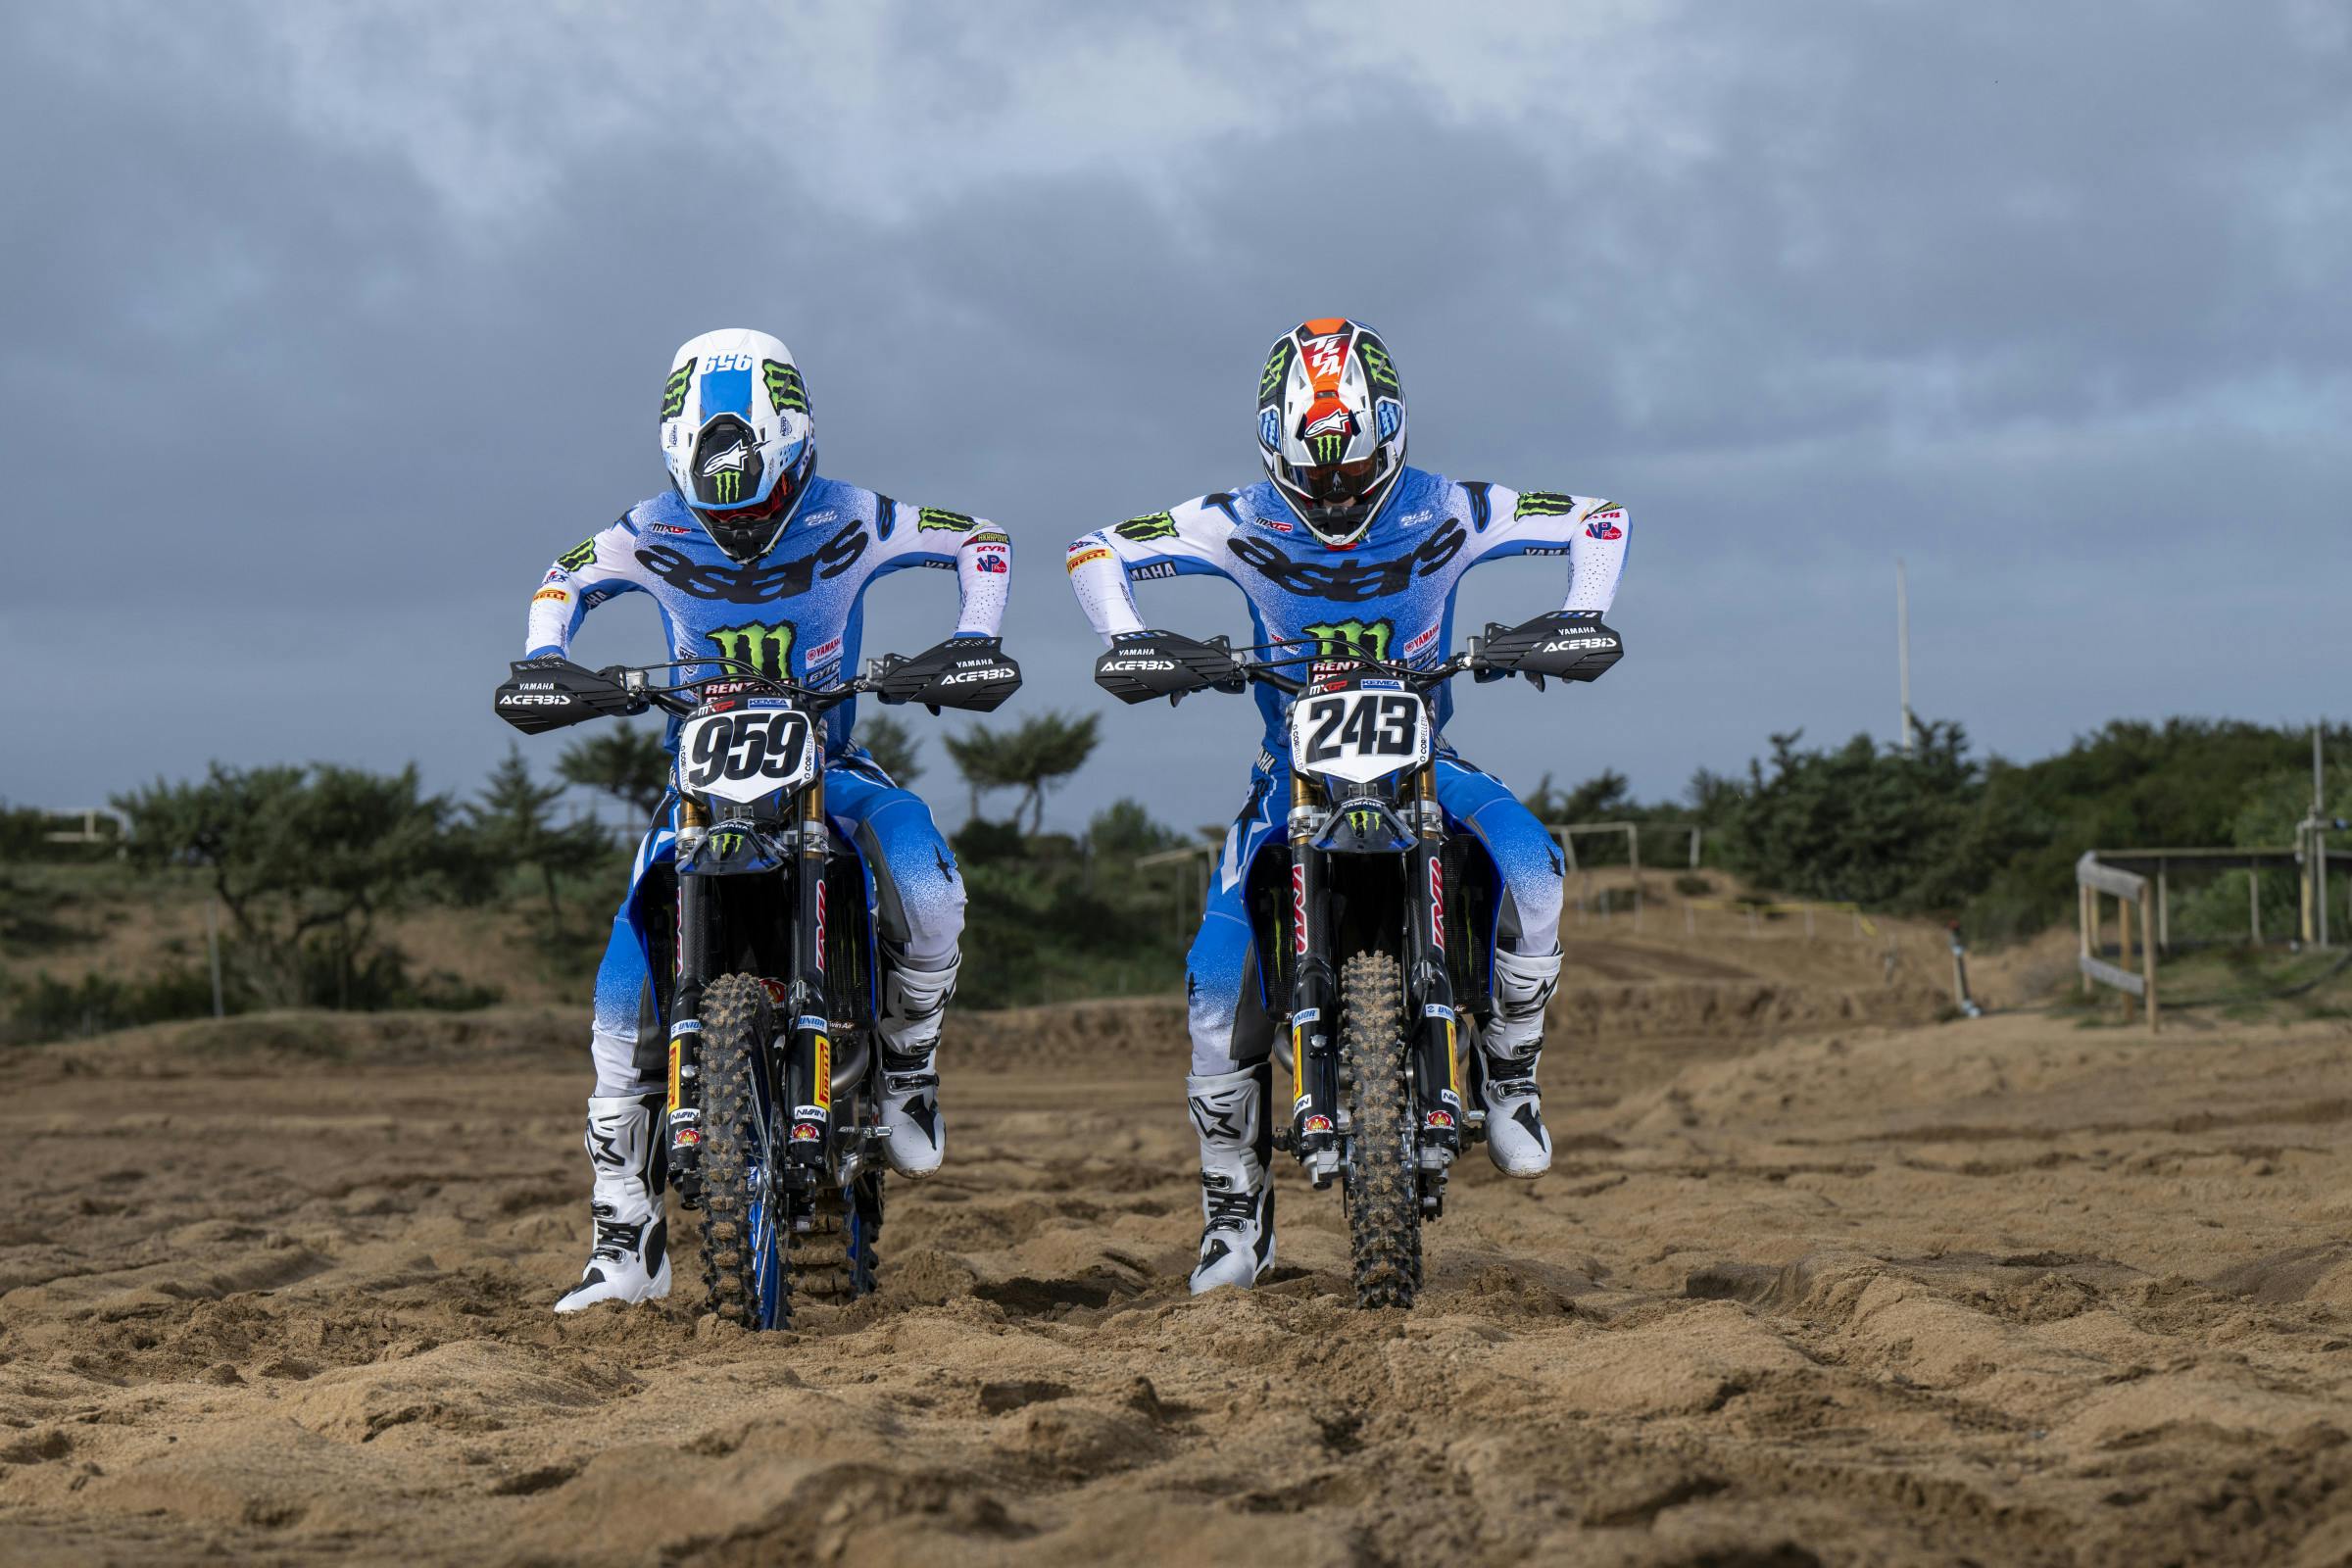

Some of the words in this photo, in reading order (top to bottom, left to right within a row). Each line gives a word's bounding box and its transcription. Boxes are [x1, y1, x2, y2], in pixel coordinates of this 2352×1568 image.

[701, 354, 753, 374] 959
[1588, 522, 1612, 540] VP
[977, 555, 1000, 572] VP
[1543, 638, 1617, 653] ACERBIS
[956, 659, 994, 668] YAMAHA
[1101, 661, 1175, 671] ACERBIS
[941, 668, 1015, 686] ACERBIS
[500, 695, 570, 706] ACERBIS
[1305, 695, 1420, 765] 243
[688, 711, 808, 789] 959
[709, 822, 749, 831] YAMAHA
[678, 1021, 702, 1030] UNIO
